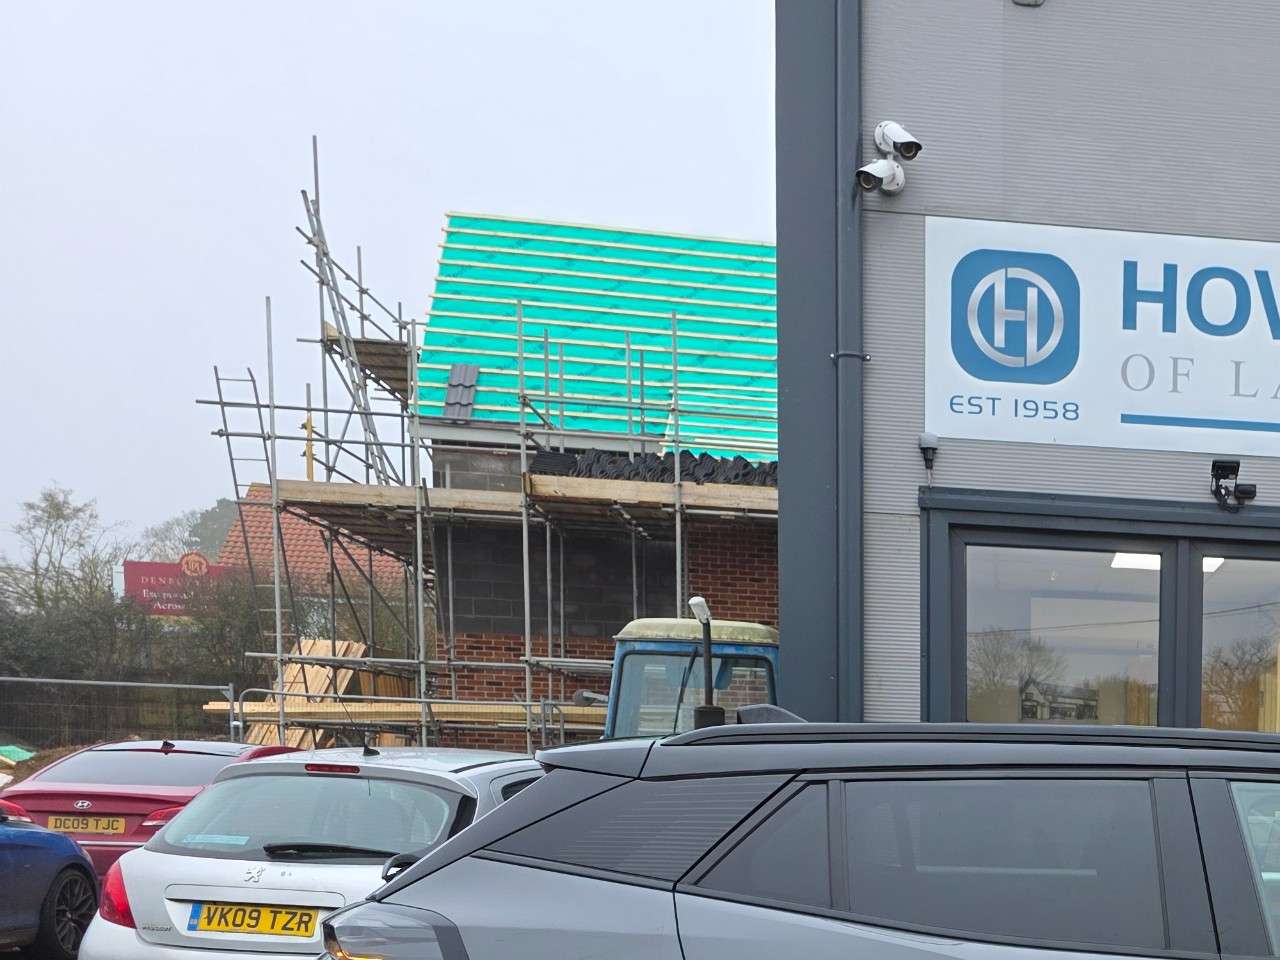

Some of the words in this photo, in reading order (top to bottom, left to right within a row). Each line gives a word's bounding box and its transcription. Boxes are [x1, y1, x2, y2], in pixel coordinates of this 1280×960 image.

[1120, 352, 1195, 393] OF
[950, 395, 1002, 416] EST
[1013, 398, 1080, 421] 1958
[54, 818, 88, 830] DC09
[93, 819, 119, 831] TJC
[205, 906, 262, 929] VK09
[268, 910, 313, 934] TZR
